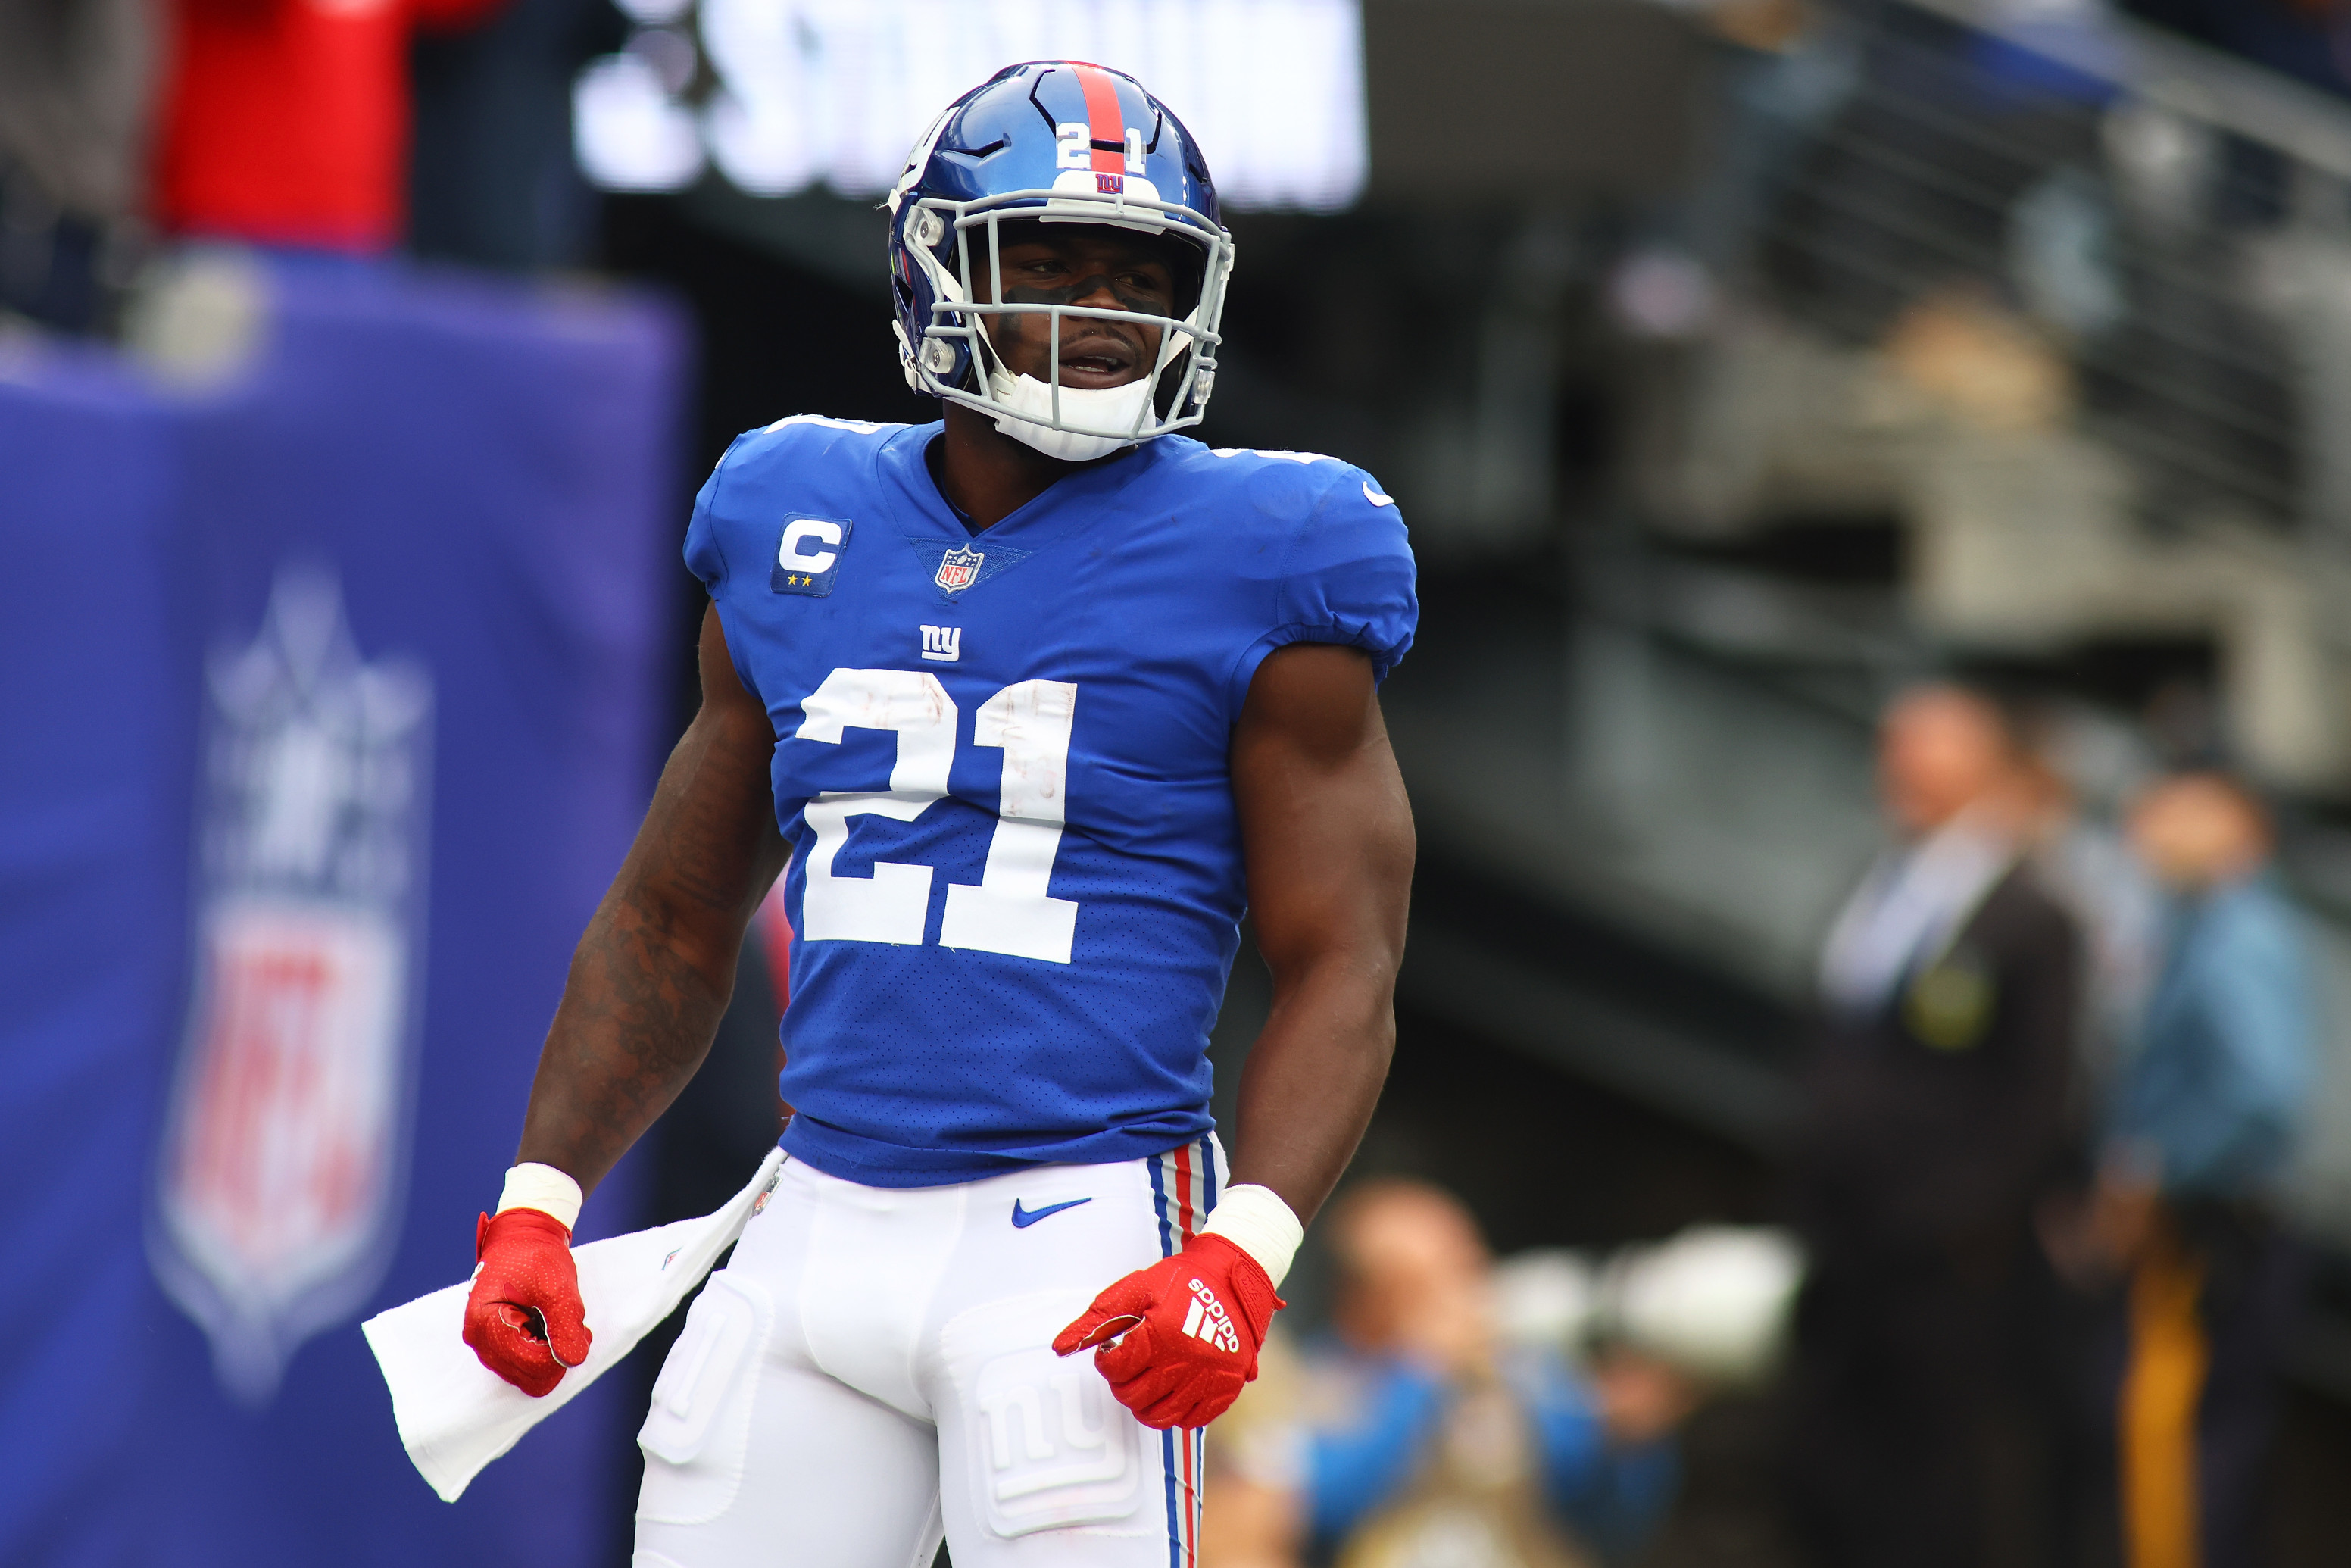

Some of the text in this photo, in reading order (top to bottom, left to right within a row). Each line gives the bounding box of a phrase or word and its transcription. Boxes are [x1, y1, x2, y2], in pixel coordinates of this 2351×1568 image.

[779, 519, 842, 573] C
[941, 565, 968, 585] NFL
[919, 624, 962, 662] ny
[795, 667, 1079, 964] 21
[1188, 1278, 1240, 1354] adidas
